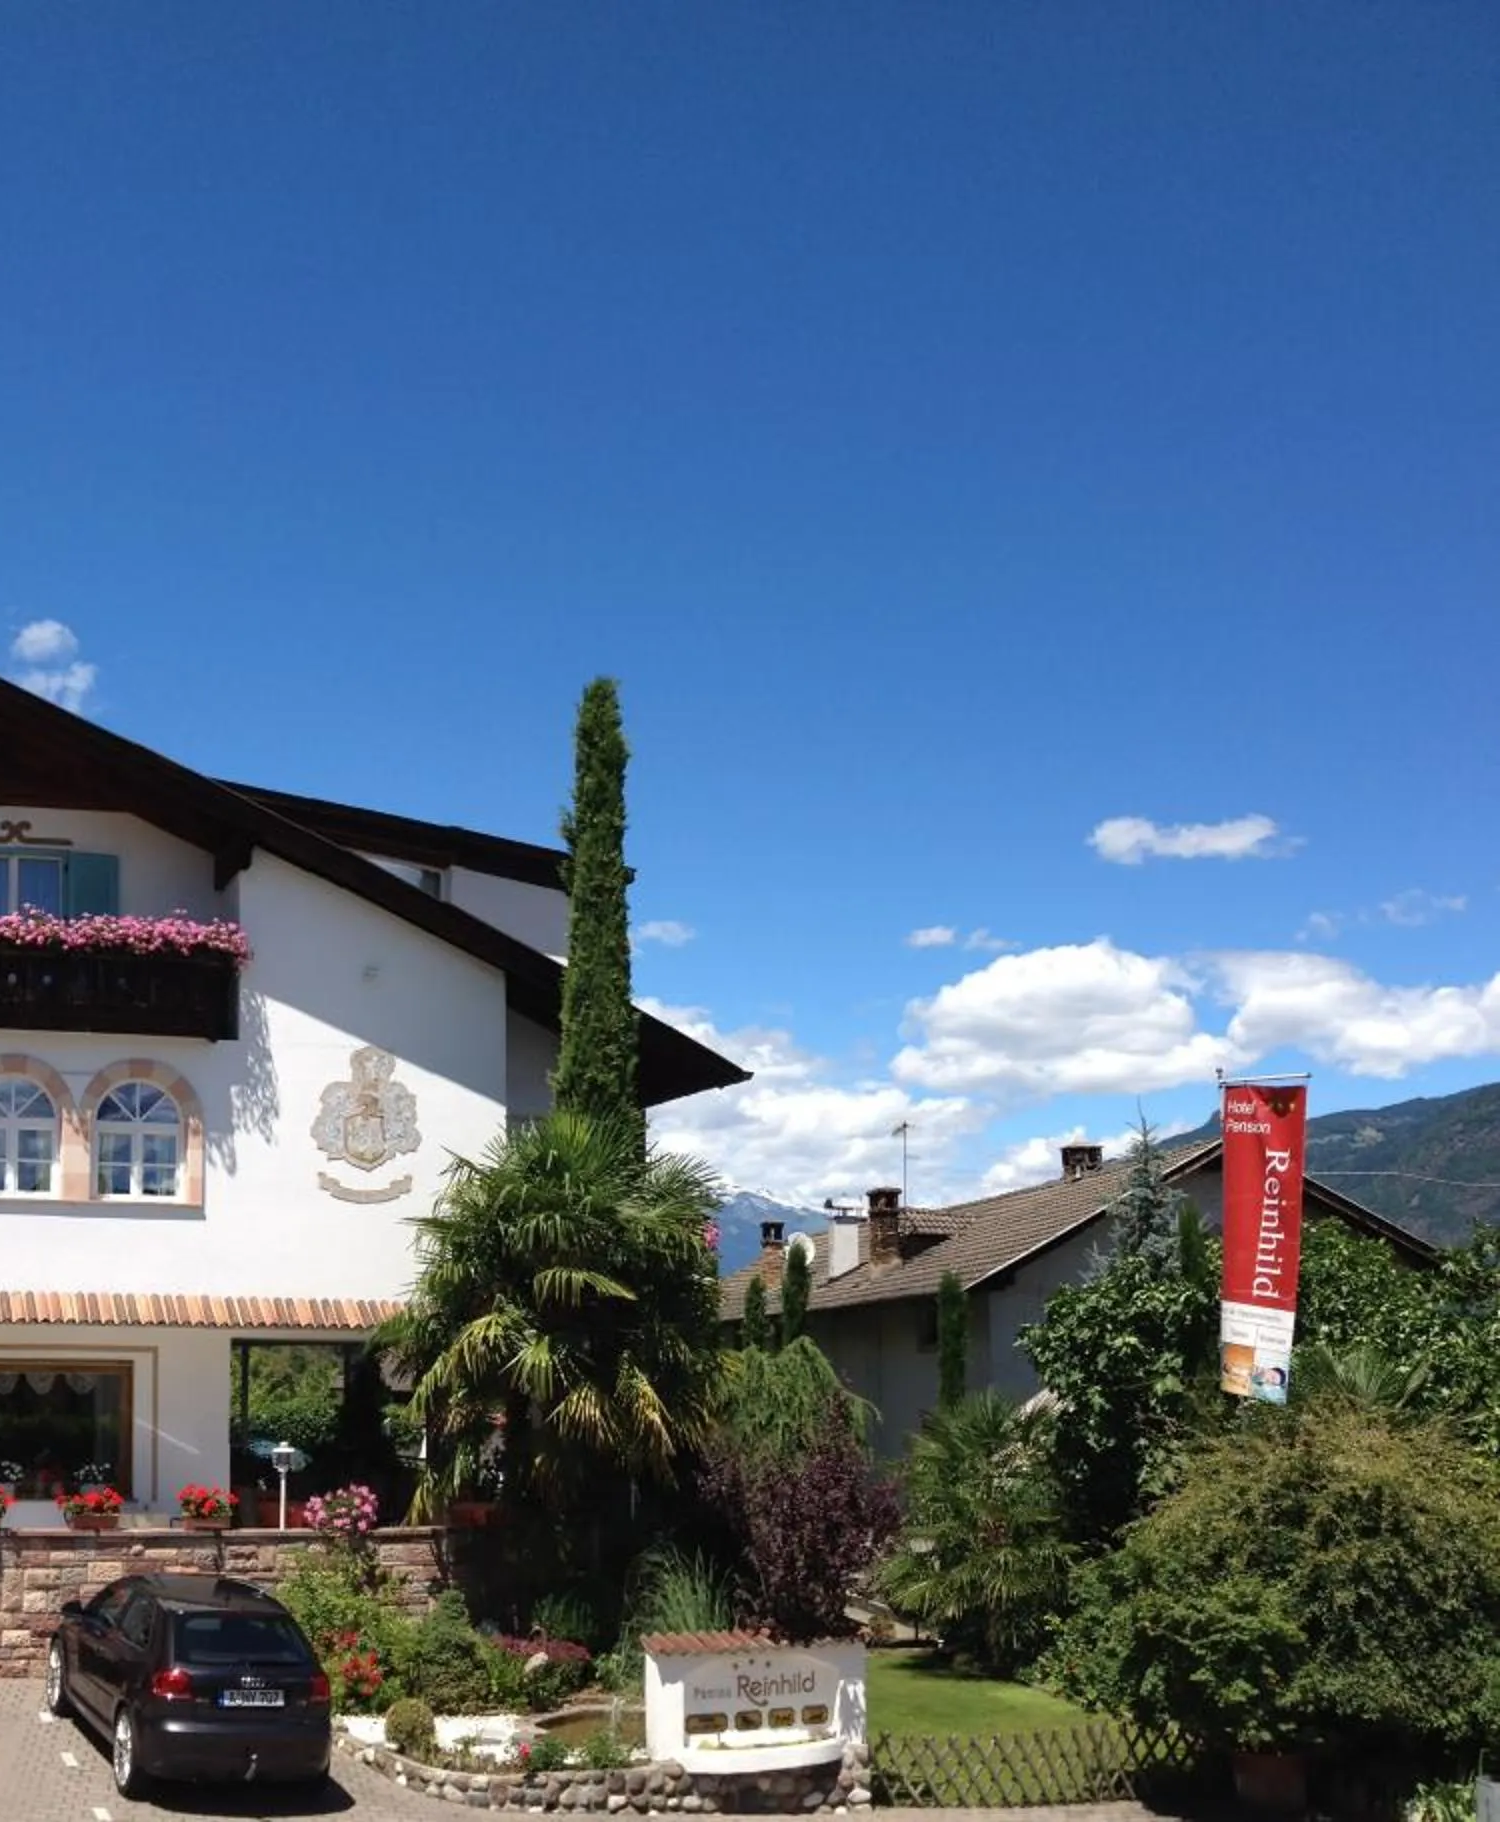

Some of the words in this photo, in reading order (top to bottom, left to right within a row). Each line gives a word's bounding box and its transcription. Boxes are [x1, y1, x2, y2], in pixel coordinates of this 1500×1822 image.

[1227, 1099, 1256, 1115] Hotel
[1226, 1117, 1271, 1134] Pension
[1251, 1147, 1291, 1299] Reinhild
[736, 1671, 817, 1707] Reinhild
